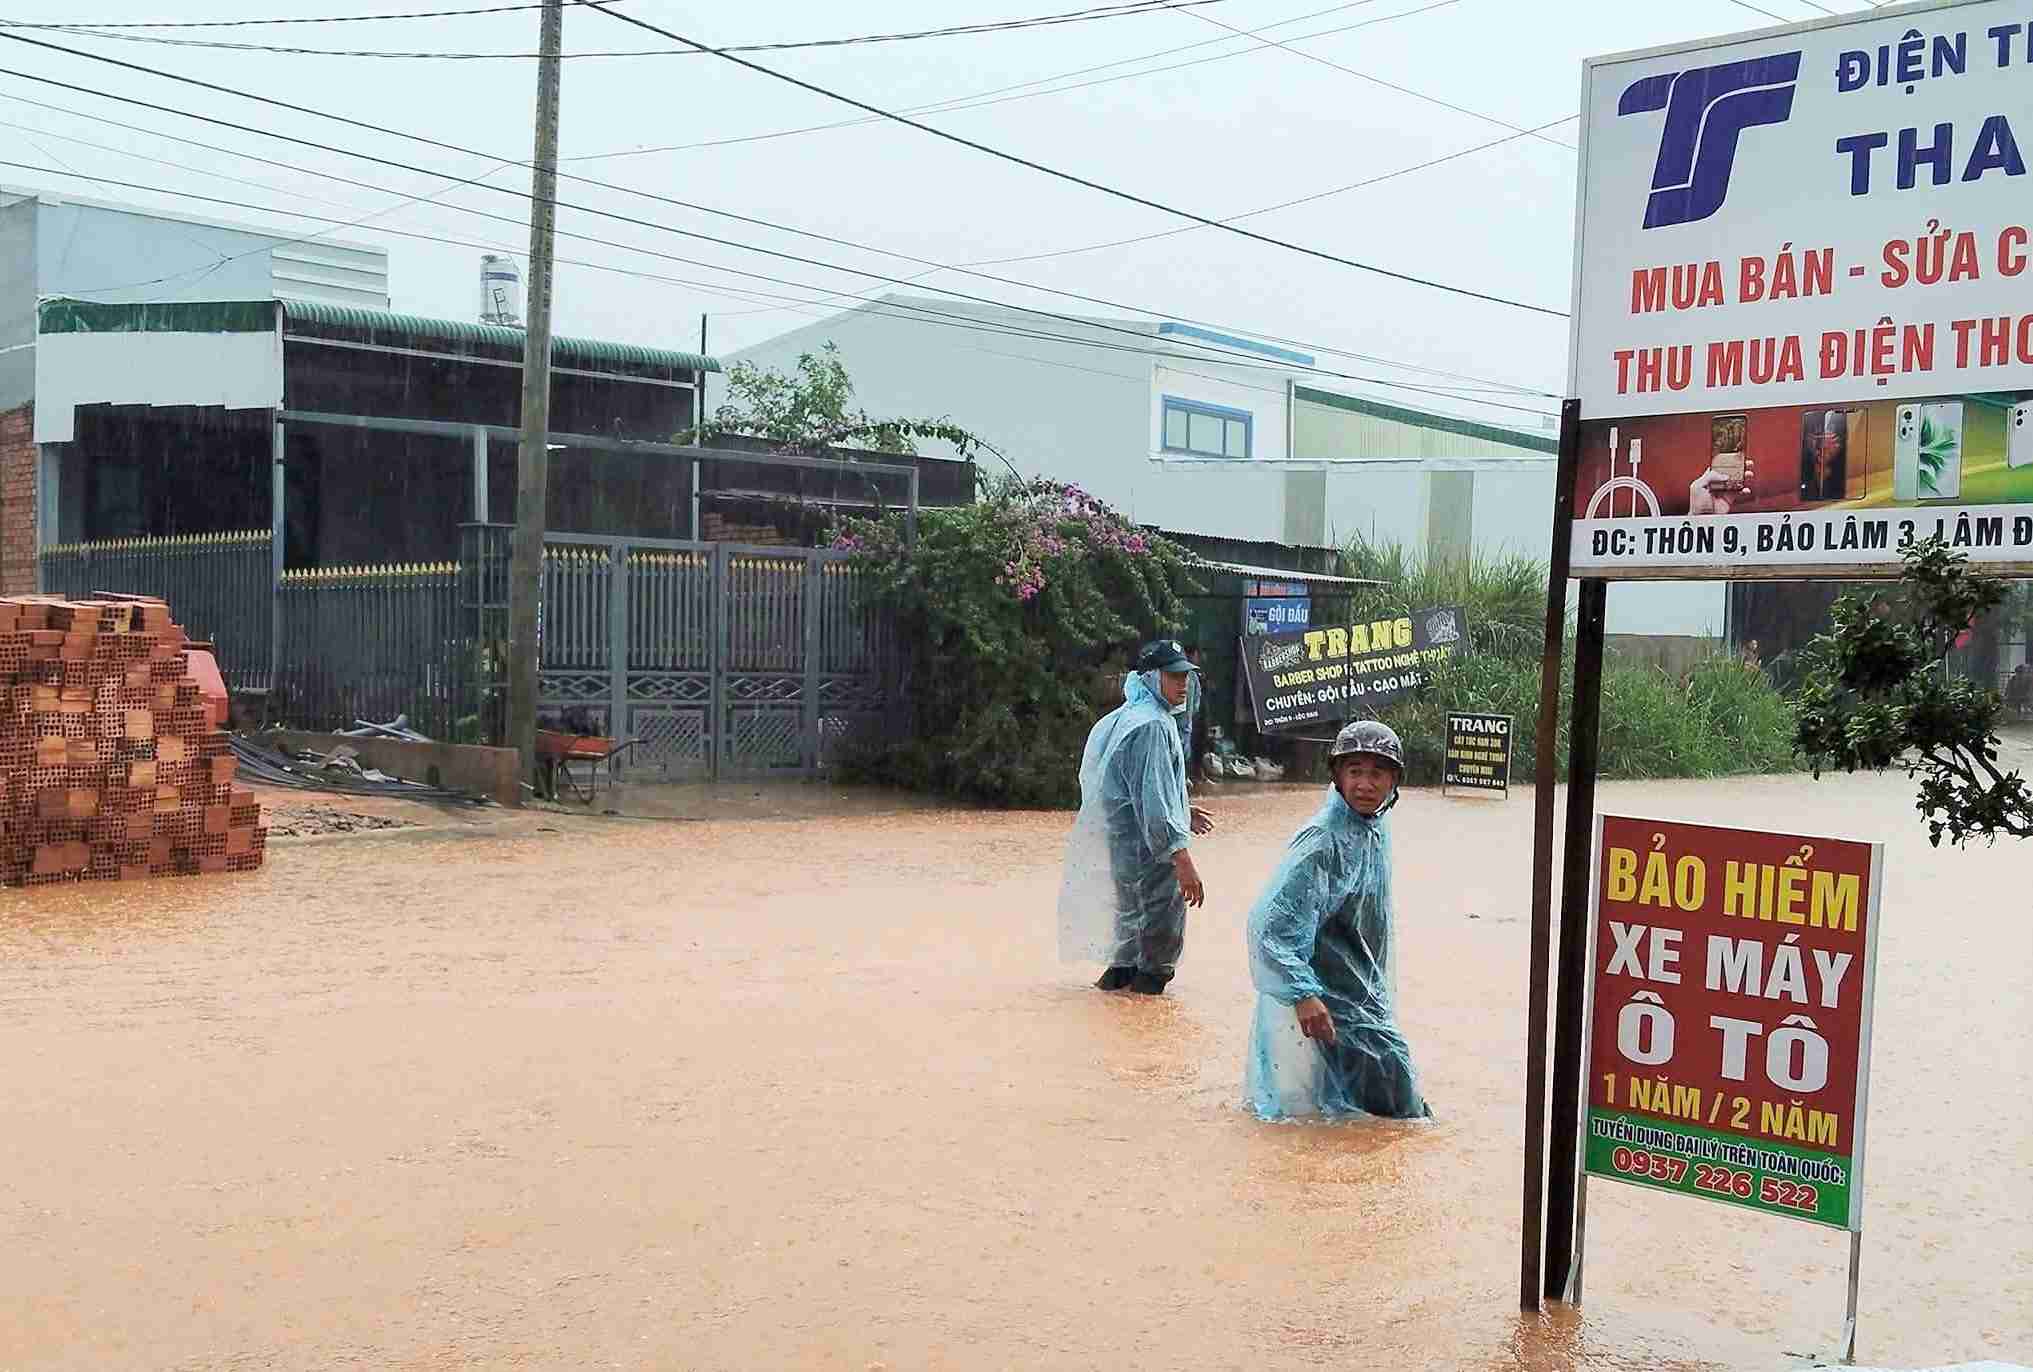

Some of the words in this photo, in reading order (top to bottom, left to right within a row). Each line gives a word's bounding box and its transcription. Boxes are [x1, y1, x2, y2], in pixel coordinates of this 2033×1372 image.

[1835, 29, 1967, 94] ĐIỆN
[1987, 21, 2033, 68] T
[1631, 261, 1724, 314] MUA
[1739, 242, 1834, 304] BÁN
[1849, 265, 1865, 278] -
[1881, 218, 1980, 288] SỬA
[1613, 345, 1692, 394] THU
[1706, 335, 1804, 388] MUA
[1819, 316, 1935, 386] ĐIỆN
[1592, 528, 1635, 556] ĐC:
[1644, 520, 1714, 555] THÔN
[1723, 526, 1747, 556] 9,
[1757, 514, 1815, 552] BẢO
[1824, 515, 1888, 550] LÂM
[1273, 670, 1315, 688] BARBER
[1315, 664, 1343, 681] SHOP
[1353, 657, 1393, 674] TATTOO
[1304, 617, 1413, 662] TRANG
[1266, 690, 1316, 711] CHUYÊN:
[1317, 685, 1340, 703] GỘI
[1373, 676, 1399, 694] CẠO
[1450, 717, 1508, 734] TRANG
[1607, 832, 1706, 912] BẢO
[1723, 844, 1860, 932] HIỂM
[1606, 920, 1683, 985] XE
[1706, 933, 1853, 1009] MÁY
[1617, 991, 1675, 1066] Ô
[1710, 1014, 1829, 1093] TÔ
[1603, 1072, 1616, 1104] 1
[1629, 1073, 1702, 1121] NĂM
[1708, 1091, 1722, 1124] /
[1731, 1096, 1750, 1130] 2
[1761, 1101, 1838, 1147] NĂM
[1613, 1146, 1689, 1184] 0937
[1695, 1163, 1752, 1199] 226
[1760, 1176, 1818, 1213] 522
[1636, 1126, 1674, 1150] DỤNG
[1676, 1134, 1699, 1159] ĐẠI
[1701, 1137, 1718, 1160] LÝ
[1721, 1143, 1758, 1169] TRÊN
[1760, 1151, 1799, 1177] TOÀN
[1800, 1157, 1846, 1186] QUỐC:
